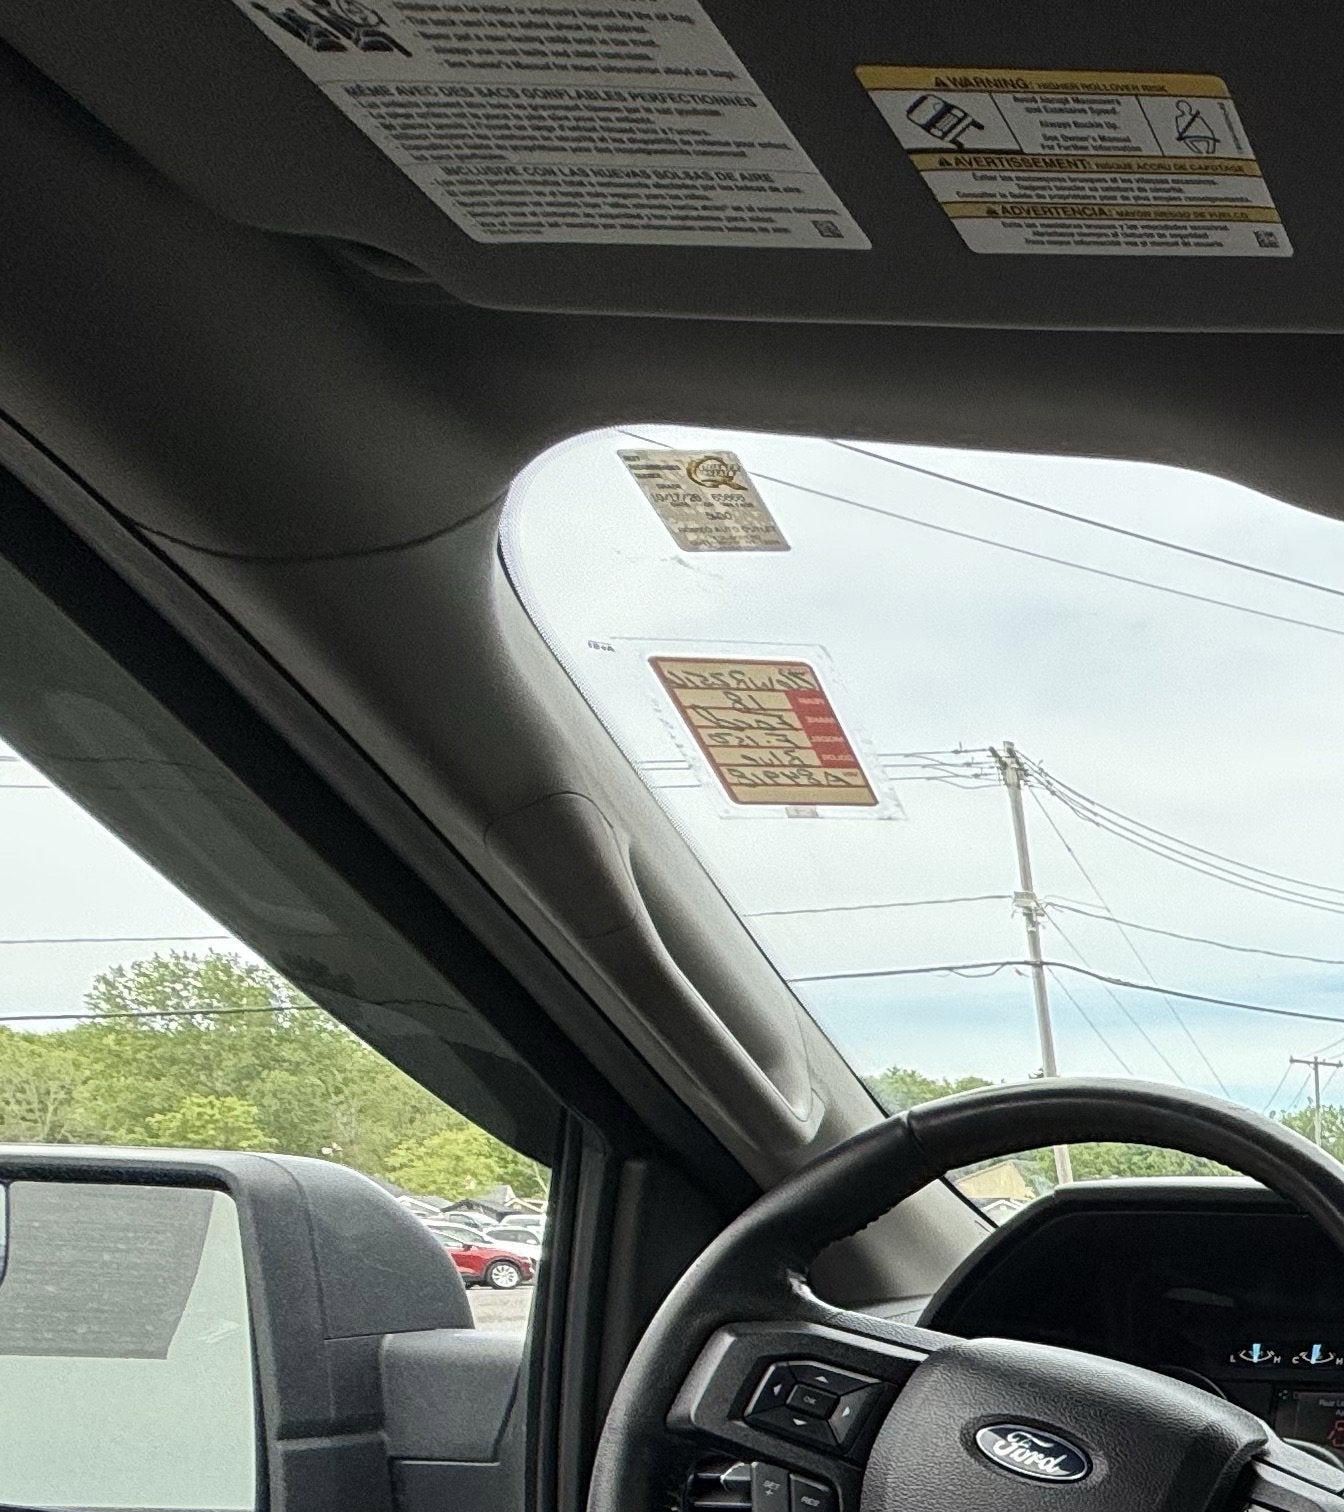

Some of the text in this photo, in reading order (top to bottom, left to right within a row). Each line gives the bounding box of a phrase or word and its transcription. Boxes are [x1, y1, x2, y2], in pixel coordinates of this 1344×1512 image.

[395, 85, 438, 98] AVEC
[475, 87, 519, 99] SACS
[1080, 83, 1140, 92] ROLLOVER
[993, 1431, 1067, 1473] Ford
